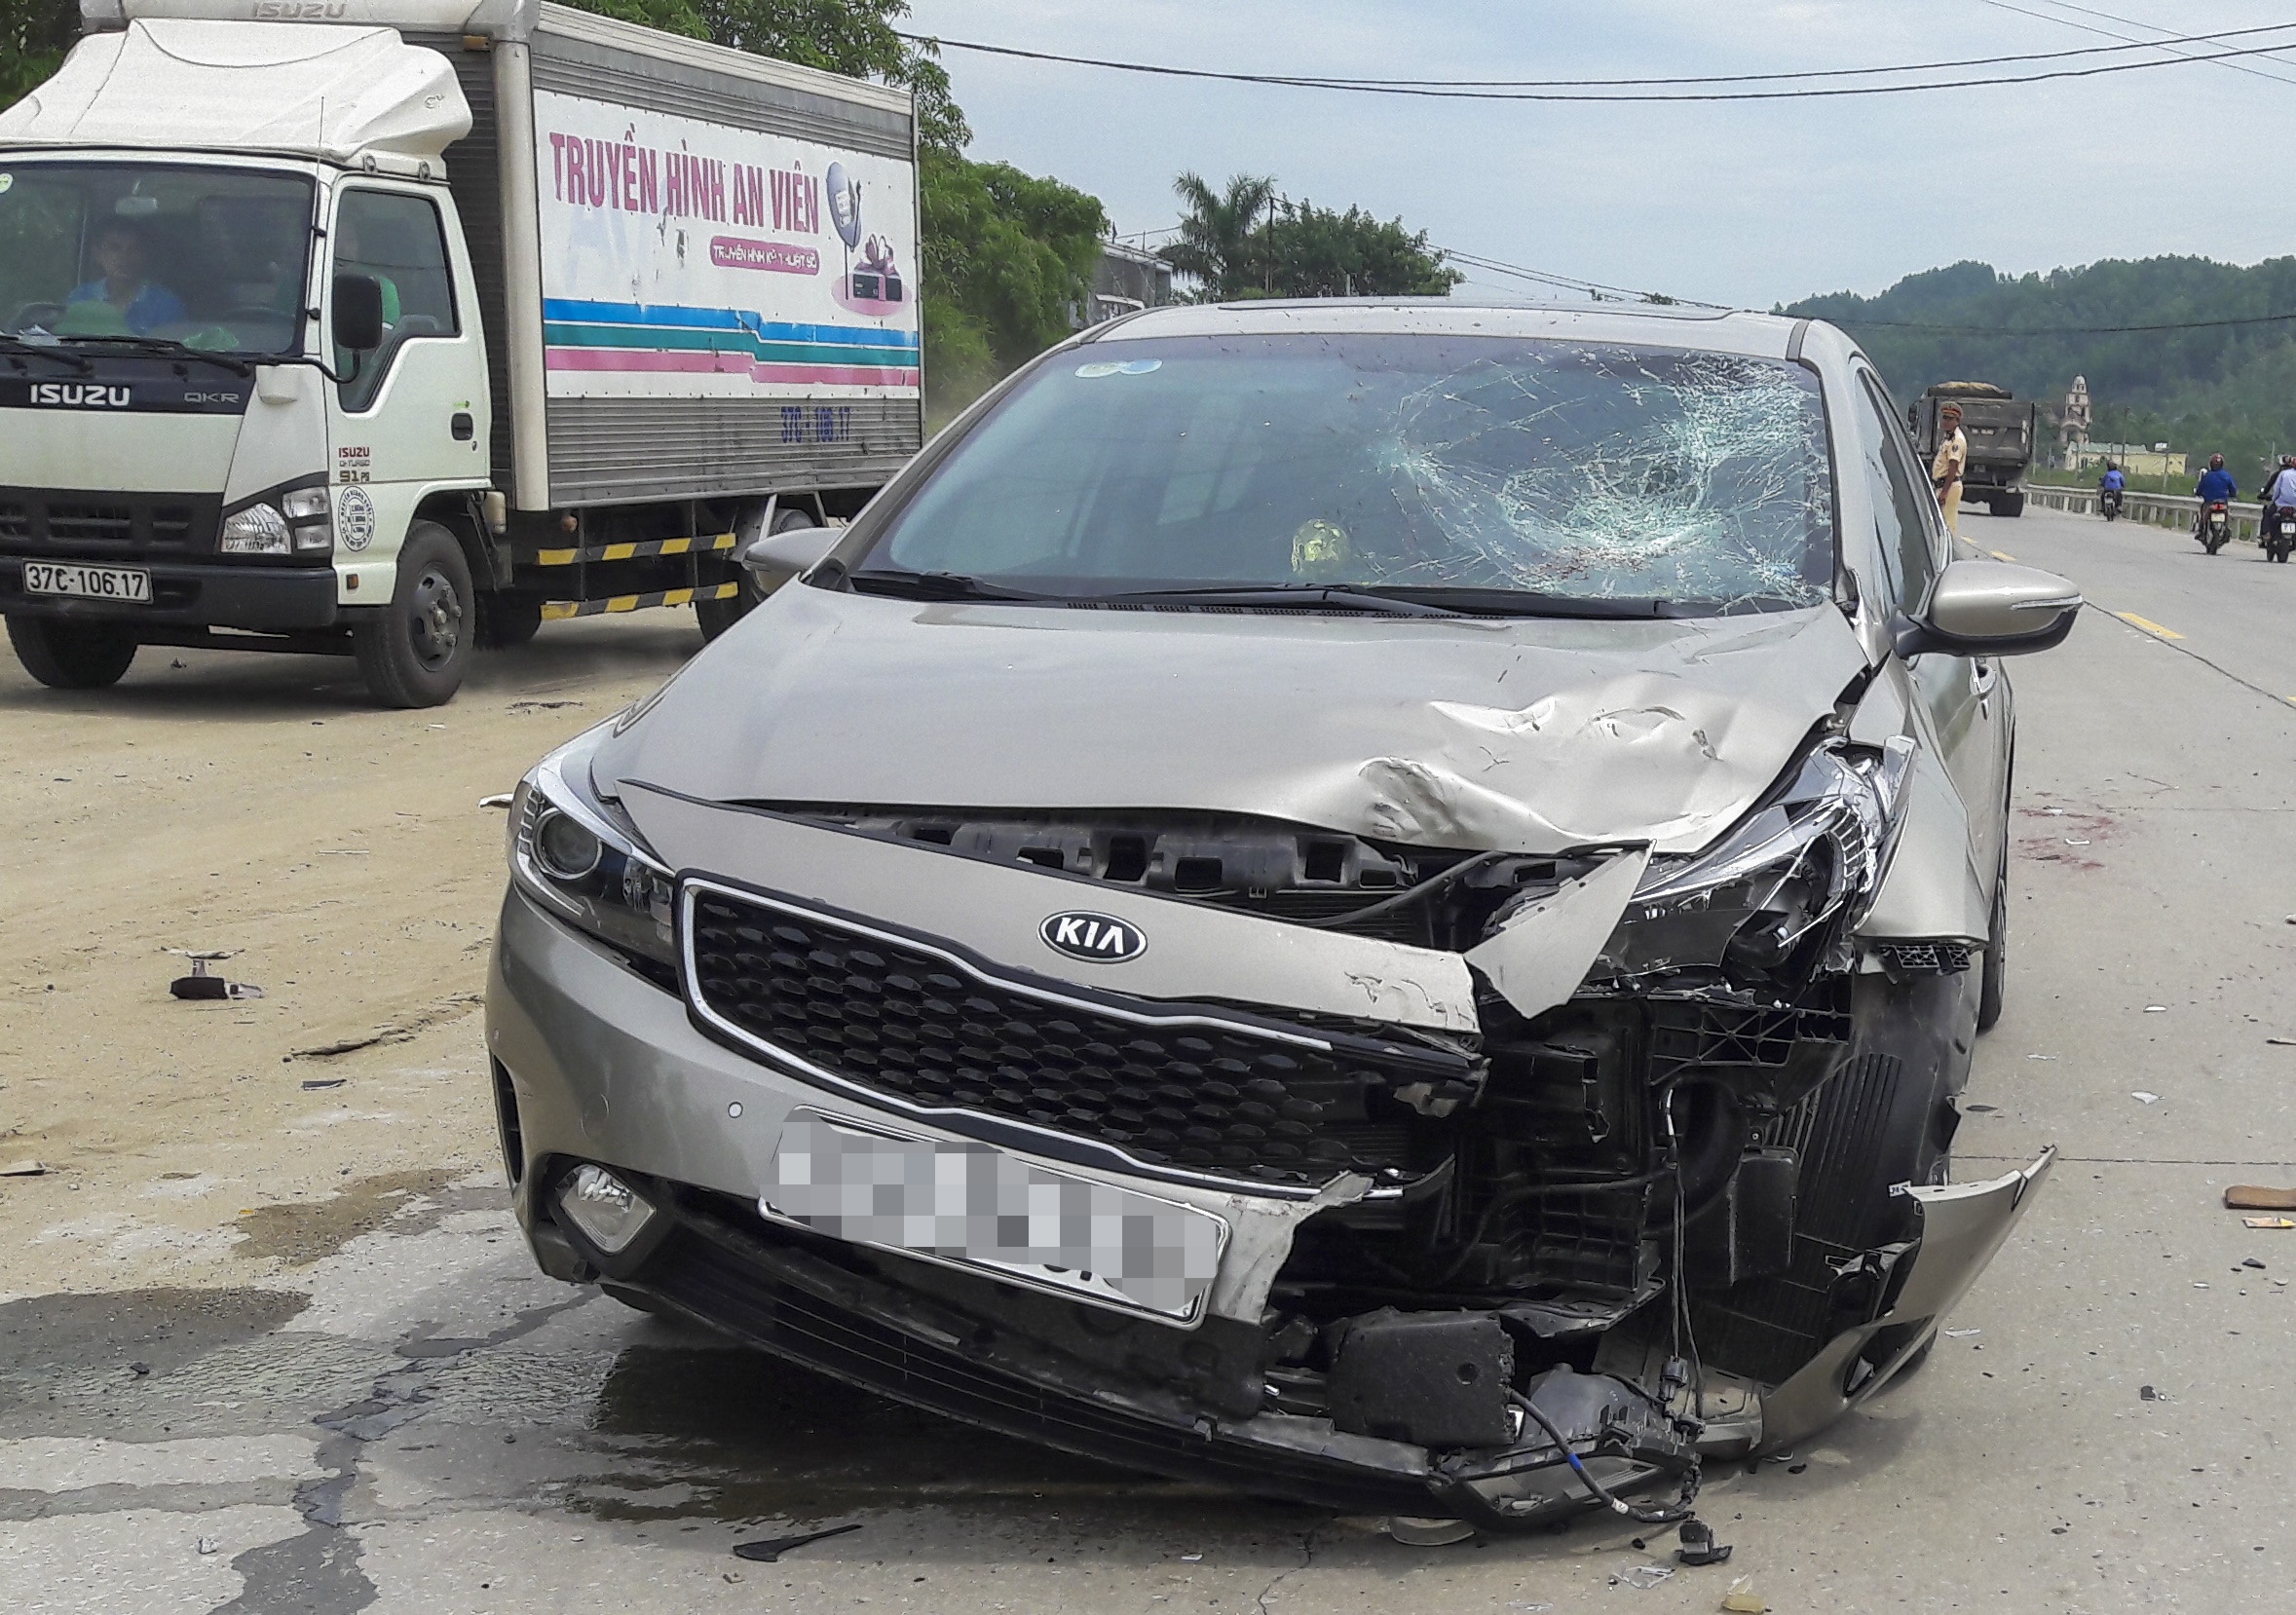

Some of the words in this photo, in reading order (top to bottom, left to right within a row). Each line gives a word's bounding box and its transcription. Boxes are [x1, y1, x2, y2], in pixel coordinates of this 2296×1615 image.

[251, 2, 347, 19] ISUZU
[549, 123, 659, 214] TRUYỀN
[665, 137, 727, 223] HÌNH
[733, 163, 765, 228] AN
[770, 160, 819, 235] VIÊN
[29, 384, 131, 406] ISUZU
[183, 392, 241, 403] QKR
[338, 446, 370, 458] ISUZU
[27, 565, 144, 597] 37C-106.17
[1055, 917, 1124, 955] KIA
